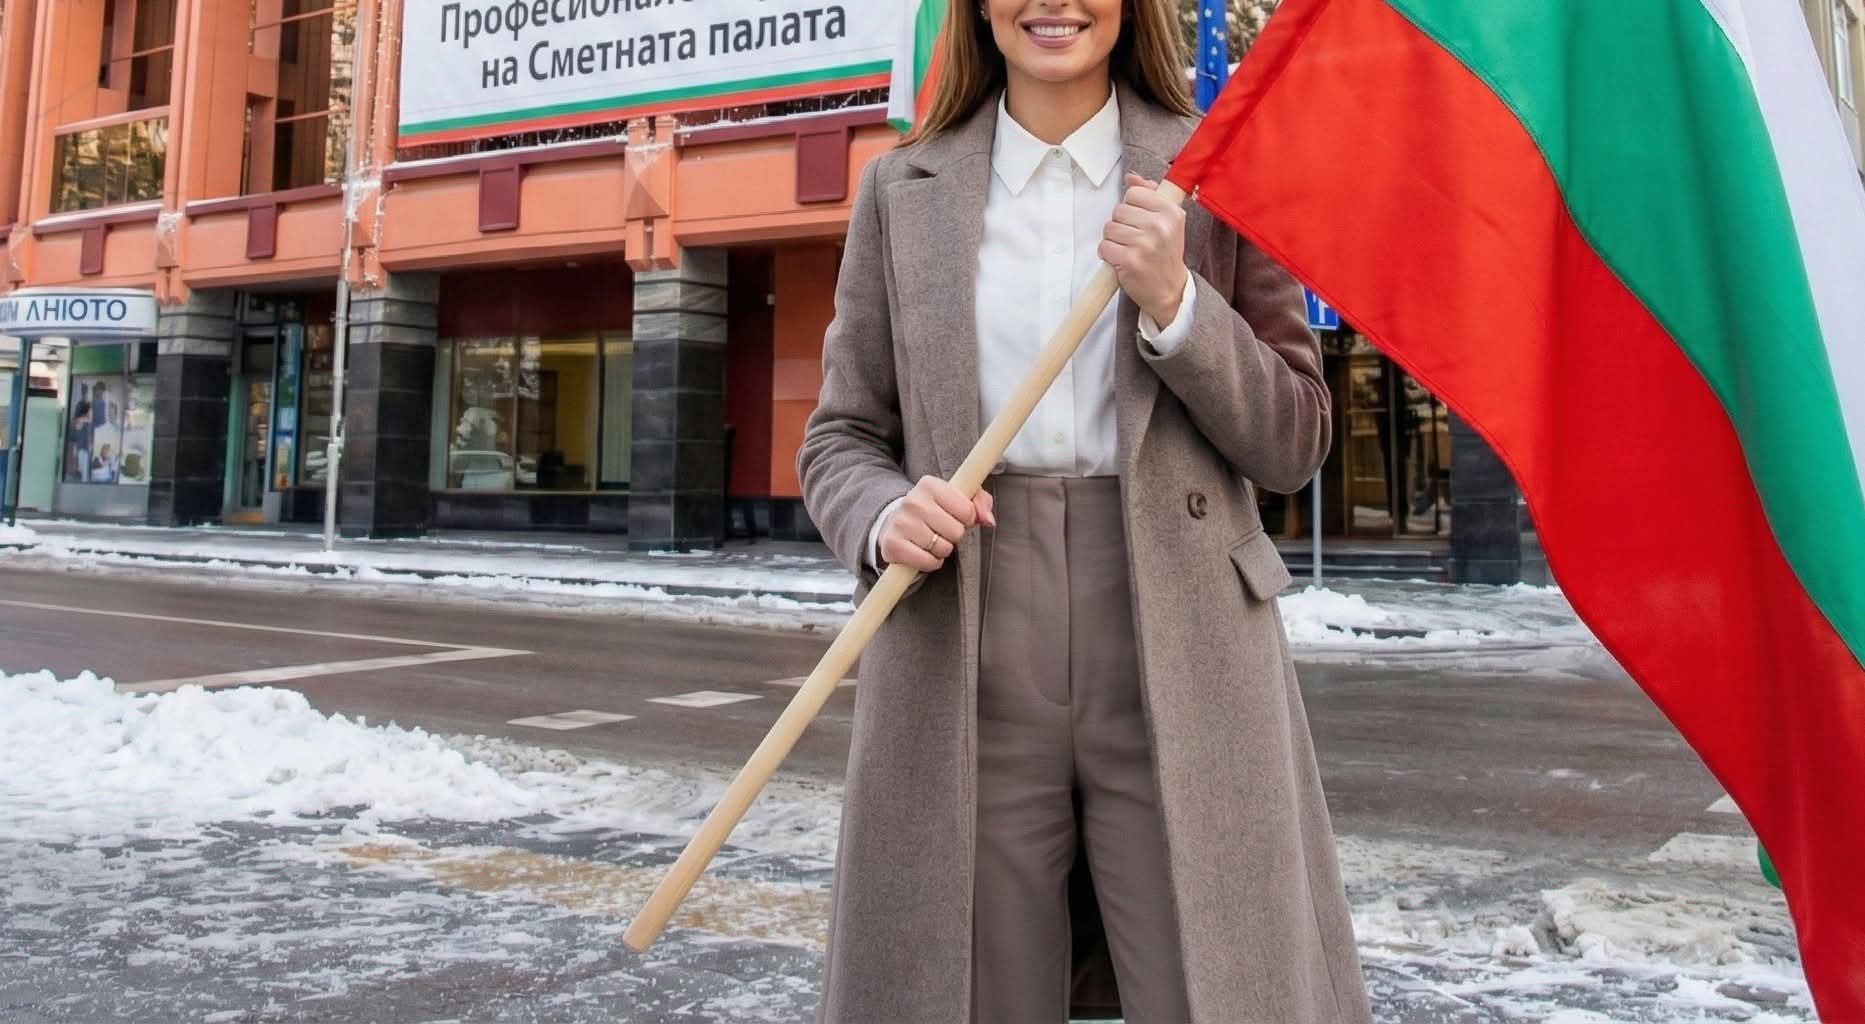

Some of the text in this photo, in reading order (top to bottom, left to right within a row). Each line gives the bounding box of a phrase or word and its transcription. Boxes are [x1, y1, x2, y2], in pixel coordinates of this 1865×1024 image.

[482, 5, 846, 89] на Сметната палата
